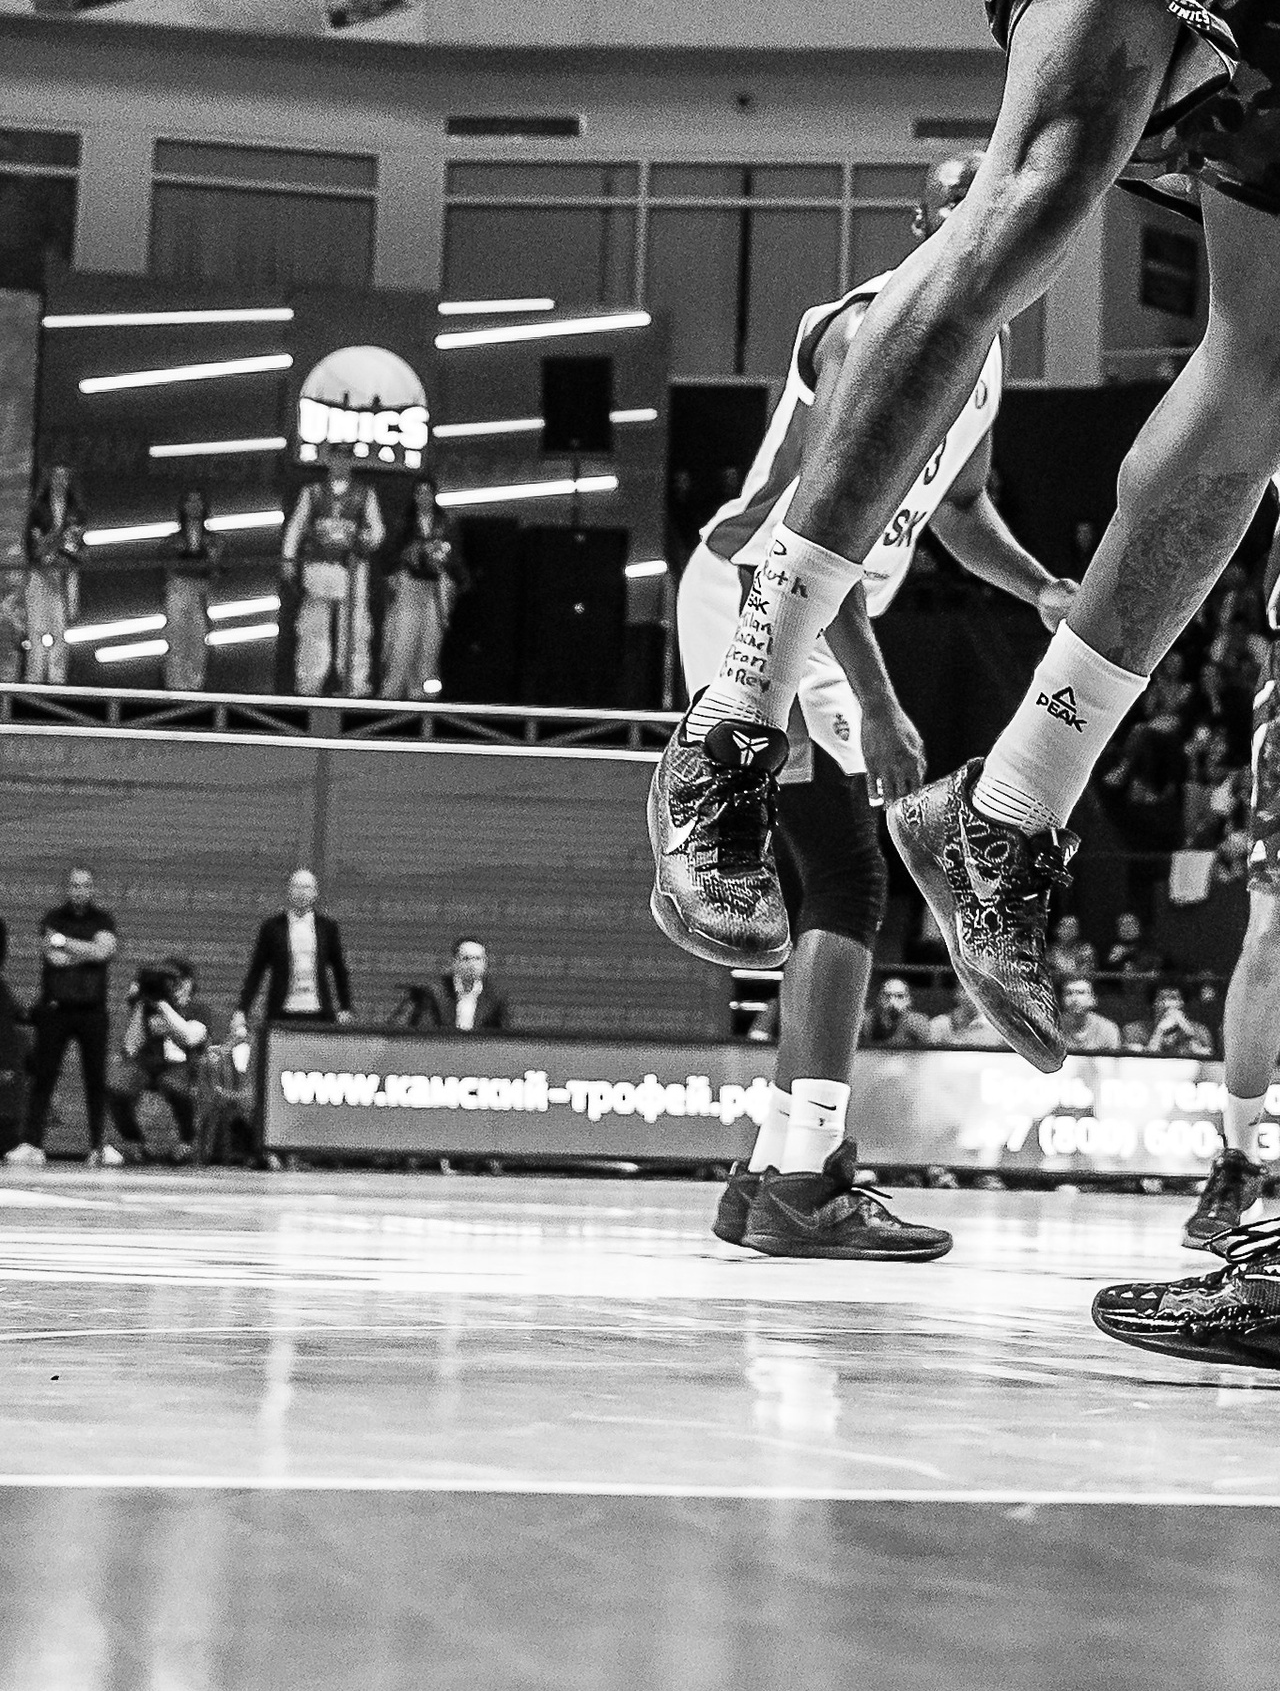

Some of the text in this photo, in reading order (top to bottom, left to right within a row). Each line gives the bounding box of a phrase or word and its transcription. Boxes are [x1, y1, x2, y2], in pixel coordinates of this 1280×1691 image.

[1168, 1, 1210, 25] UNICS
[299, 396, 430, 450] UNICS
[1035, 691, 1088, 733] PEAK
